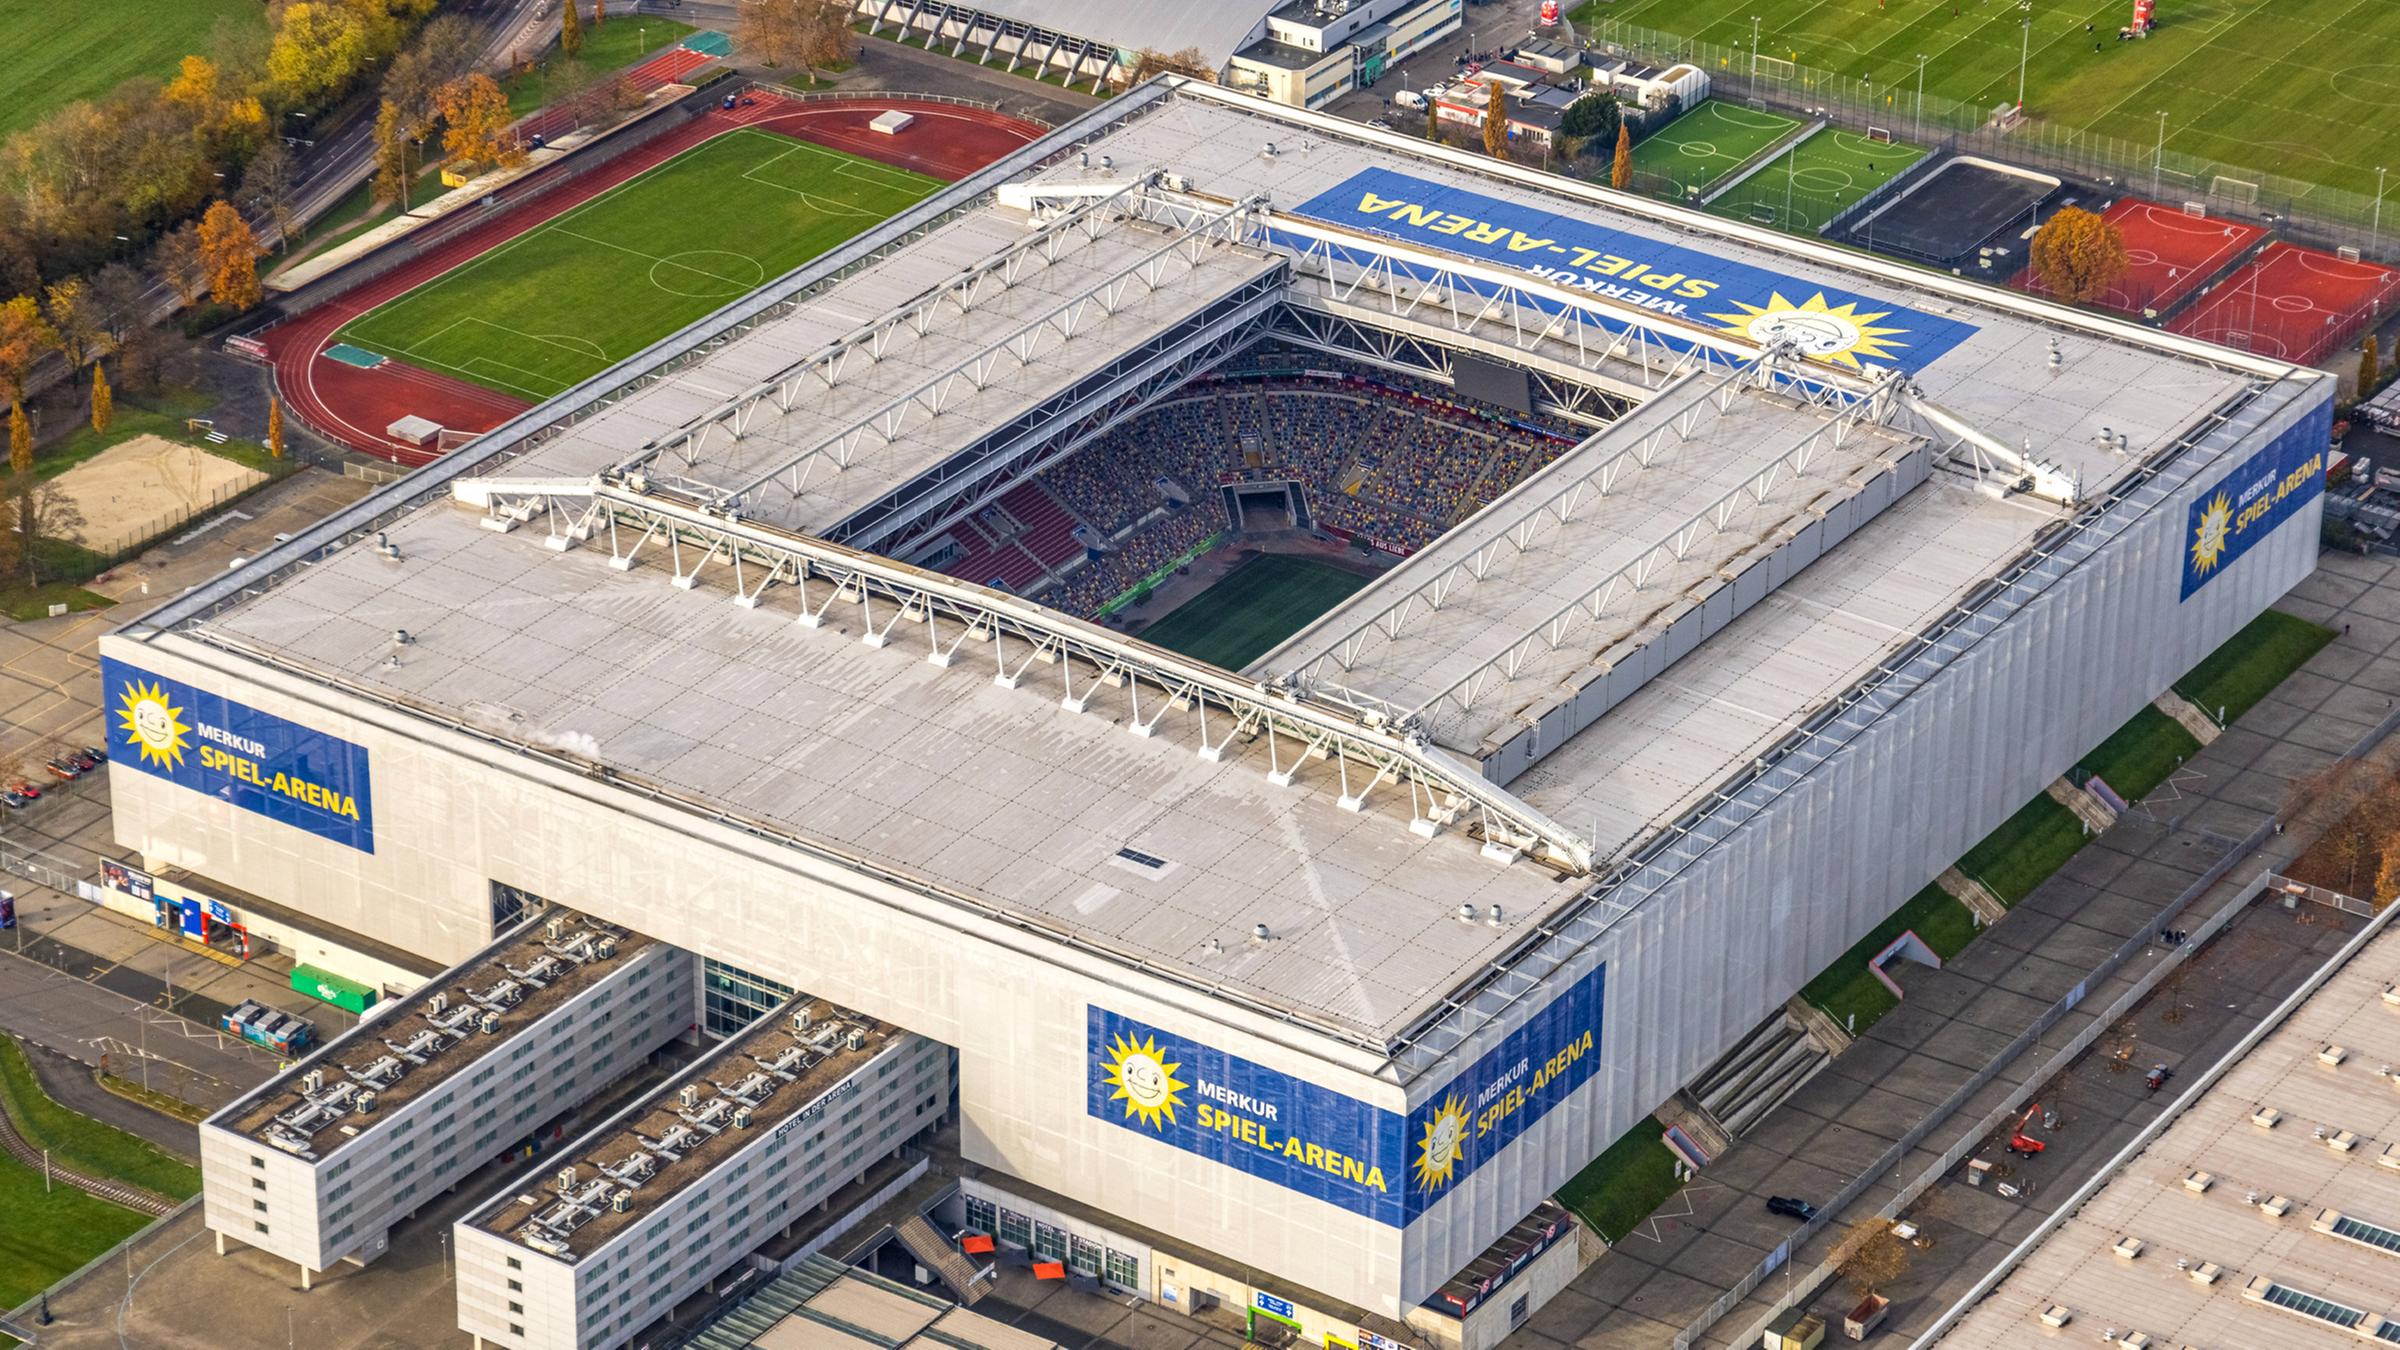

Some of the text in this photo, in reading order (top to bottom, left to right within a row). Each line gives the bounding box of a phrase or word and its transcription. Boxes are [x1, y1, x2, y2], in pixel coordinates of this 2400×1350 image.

[1357, 191, 1720, 299] SPIEL-ARENA
[1526, 264, 1688, 315] MERKUR
[2235, 453, 2321, 535] SPIEL-ARENA
[2238, 469, 2277, 507] MERKUR
[198, 722, 266, 758] MERKUR
[200, 745, 360, 821] SPIEL-ARENA
[778, 1116, 801, 1137] HOTEL
[811, 1098, 826, 1113] DER
[828, 1082, 851, 1101] ARENA
[1197, 1079, 1278, 1121] MERKUR
[1477, 1030, 1593, 1138] SPIEL-ARENA
[1478, 1057, 1529, 1108] MERKUR
[1197, 1103, 1387, 1193] SPIEL-ARENA
